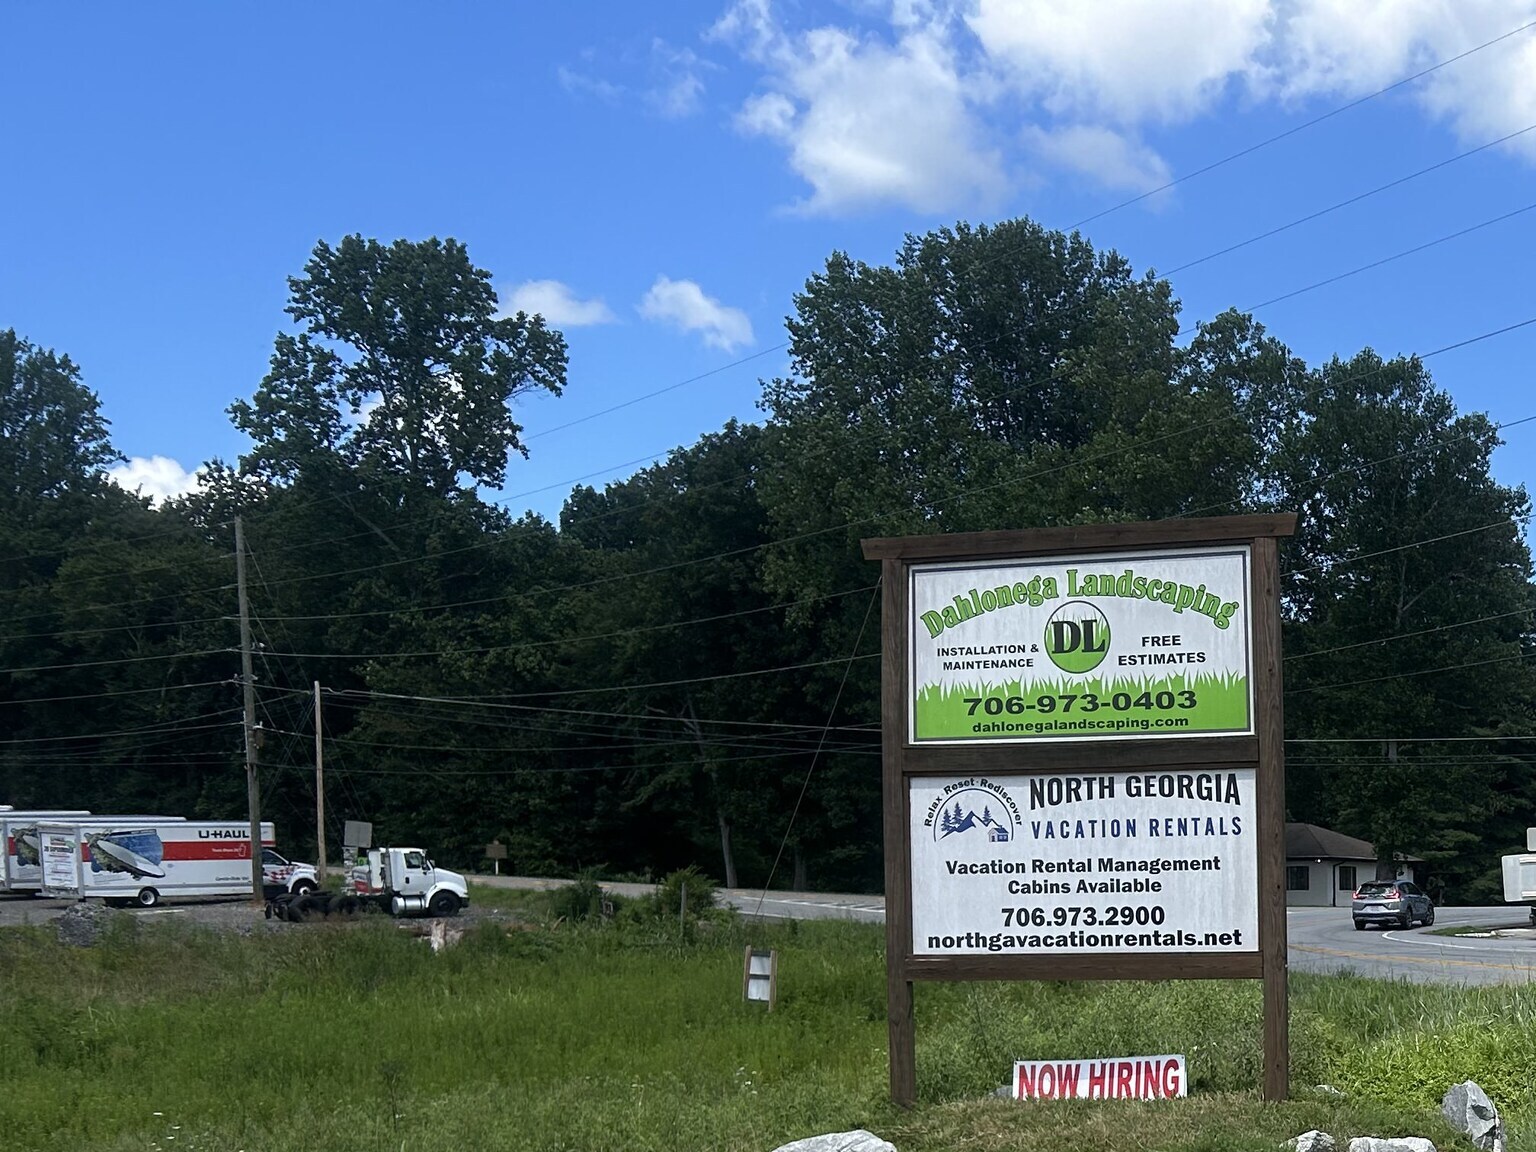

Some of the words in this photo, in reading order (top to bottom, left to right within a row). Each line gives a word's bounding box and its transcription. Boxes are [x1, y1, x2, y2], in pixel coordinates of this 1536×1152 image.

[919, 574, 1059, 639] Dahlonega
[1066, 569, 1241, 630] Landscaping
[1051, 619, 1106, 655] DL
[1141, 635, 1182, 648] FREE
[936, 644, 1027, 657] INSTALLATION
[1030, 643, 1040, 654] &
[1118, 652, 1207, 667] ESTIMATES
[942, 658, 1034, 671] MAINTENANCE
[963, 690, 1199, 716] 706-973-0403
[972, 716, 1190, 733] dahlonegalandscaping.com
[924, 795, 943, 827] Relax
[943, 777, 976, 795] Reset
[980, 778, 1022, 826] Rediscover
[1029, 775, 1115, 810] NORTH
[1125, 773, 1241, 805] GEORGIA
[198, 830, 250, 839] U-HAUL
[1031, 818, 1137, 840] VACATION
[1149, 816, 1242, 838] RENTALS
[945, 859, 1026, 875] Vacation
[1031, 858, 1092, 874] Rental
[1098, 855, 1221, 875] Management
[1008, 879, 1071, 895] Cabins
[1076, 877, 1162, 894] Available
[1001, 905, 1165, 928] 706.973.2900
[928, 929, 1242, 952] northgavacationrentals.net
[1017, 1063, 1081, 1100] NOW
[1088, 1059, 1180, 1099] HIRING
